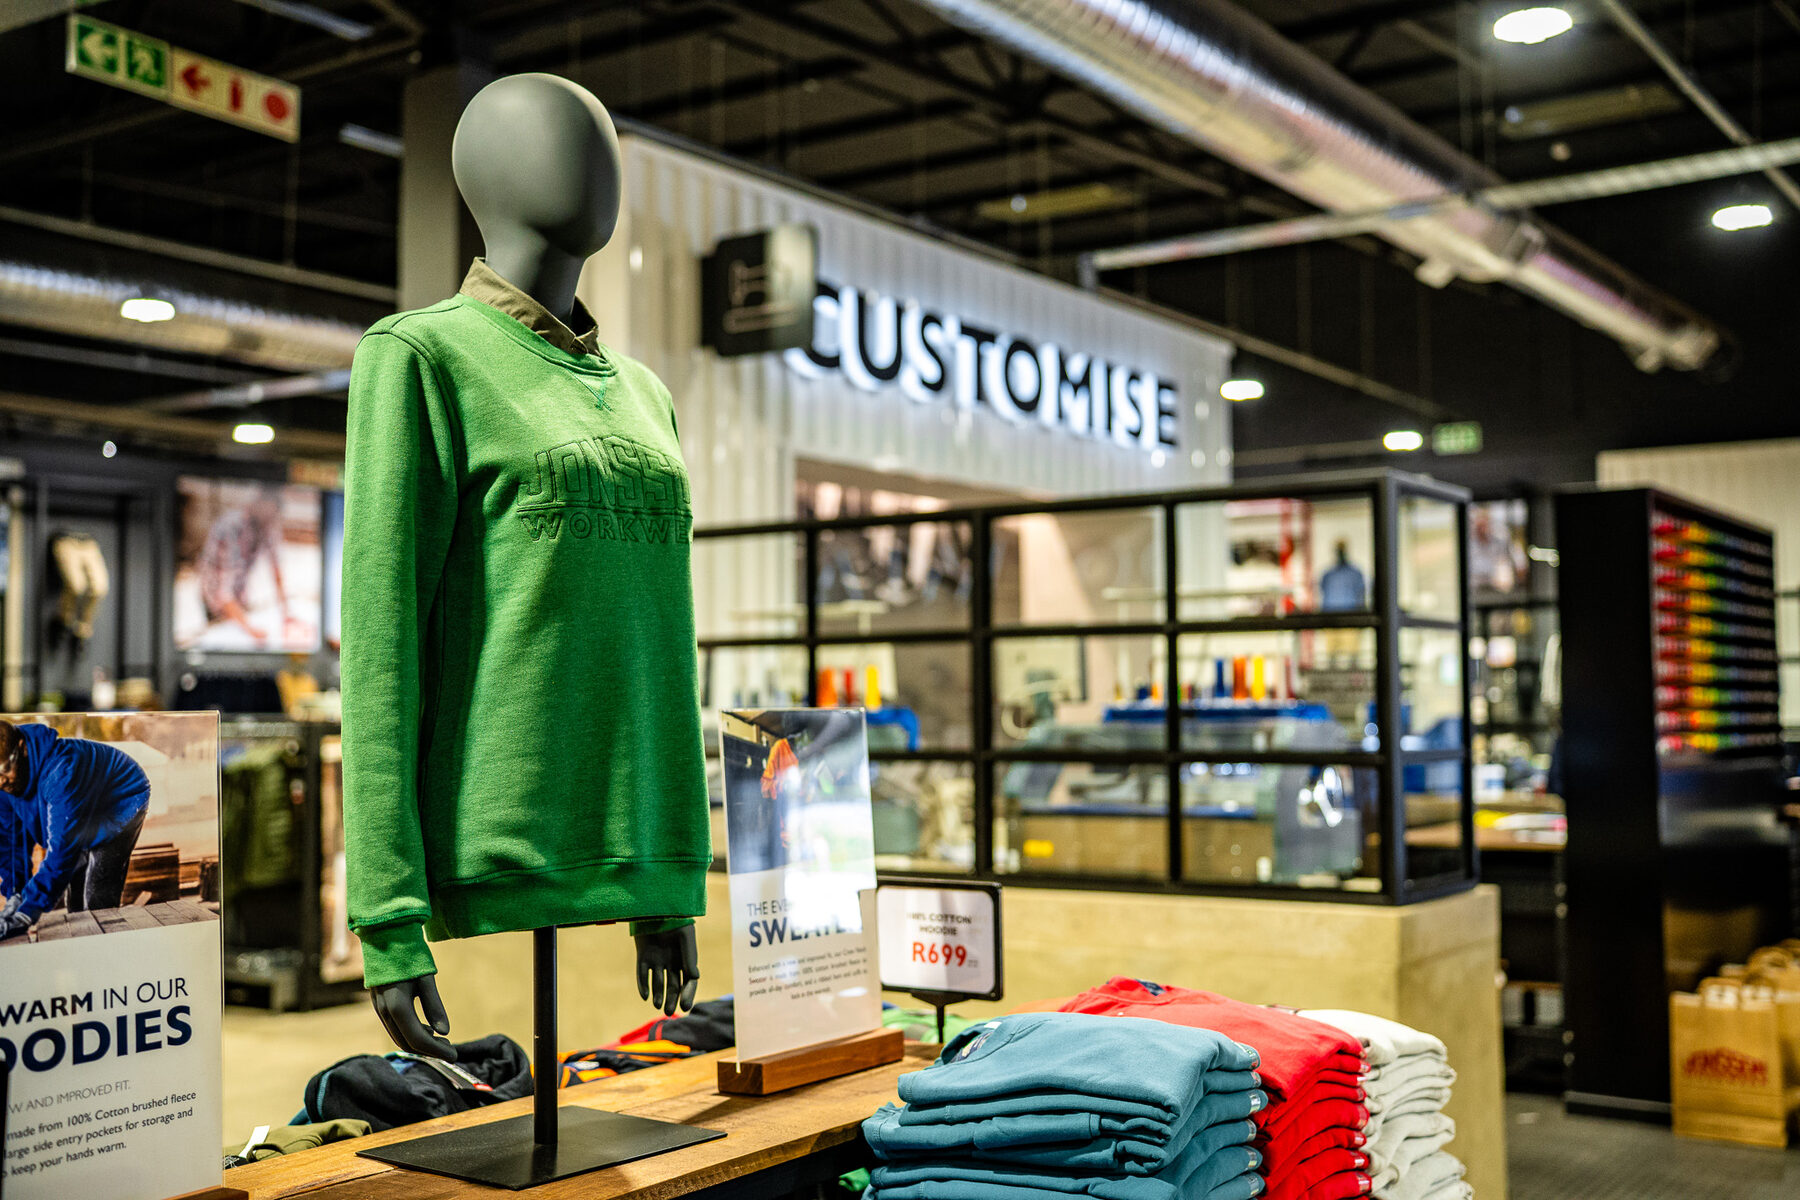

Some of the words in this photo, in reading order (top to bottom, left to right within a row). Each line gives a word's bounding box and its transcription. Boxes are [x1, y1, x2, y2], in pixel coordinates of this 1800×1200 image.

[803, 281, 1179, 448] CUSTOMISE
[746, 900, 769, 917] THE
[928, 912, 973, 925] COTTON
[919, 924, 958, 937] HOODIE
[912, 941, 968, 968] R699
[0, 991, 93, 1028] WARM
[103, 986, 127, 1010] IN
[136, 977, 189, 1003] OUR
[26, 1095, 54, 1111] AND
[56, 1083, 112, 1104] IMPROVED
[114, 1079, 131, 1092] FIT.
[7, 1125, 36, 1140] made
[38, 1120, 63, 1134] from
[67, 1111, 93, 1127] 100%
[95, 1106, 130, 1121] Cotton
[132, 1095, 169, 1113] brushed
[171, 1092, 197, 1104] fleece
[33, 1139, 54, 1153] side
[56, 1133, 84, 1148] entry
[86, 1124, 123, 1142] pockets
[125, 1120, 140, 1131] for
[142, 1112, 175, 1127] storage
[177, 1106, 193, 1119] and
[11, 1162, 37, 1176] keep
[39, 1155, 64, 1172] your
[66, 1146, 95, 1162] hands
[97, 1141, 127, 1155] warm.
